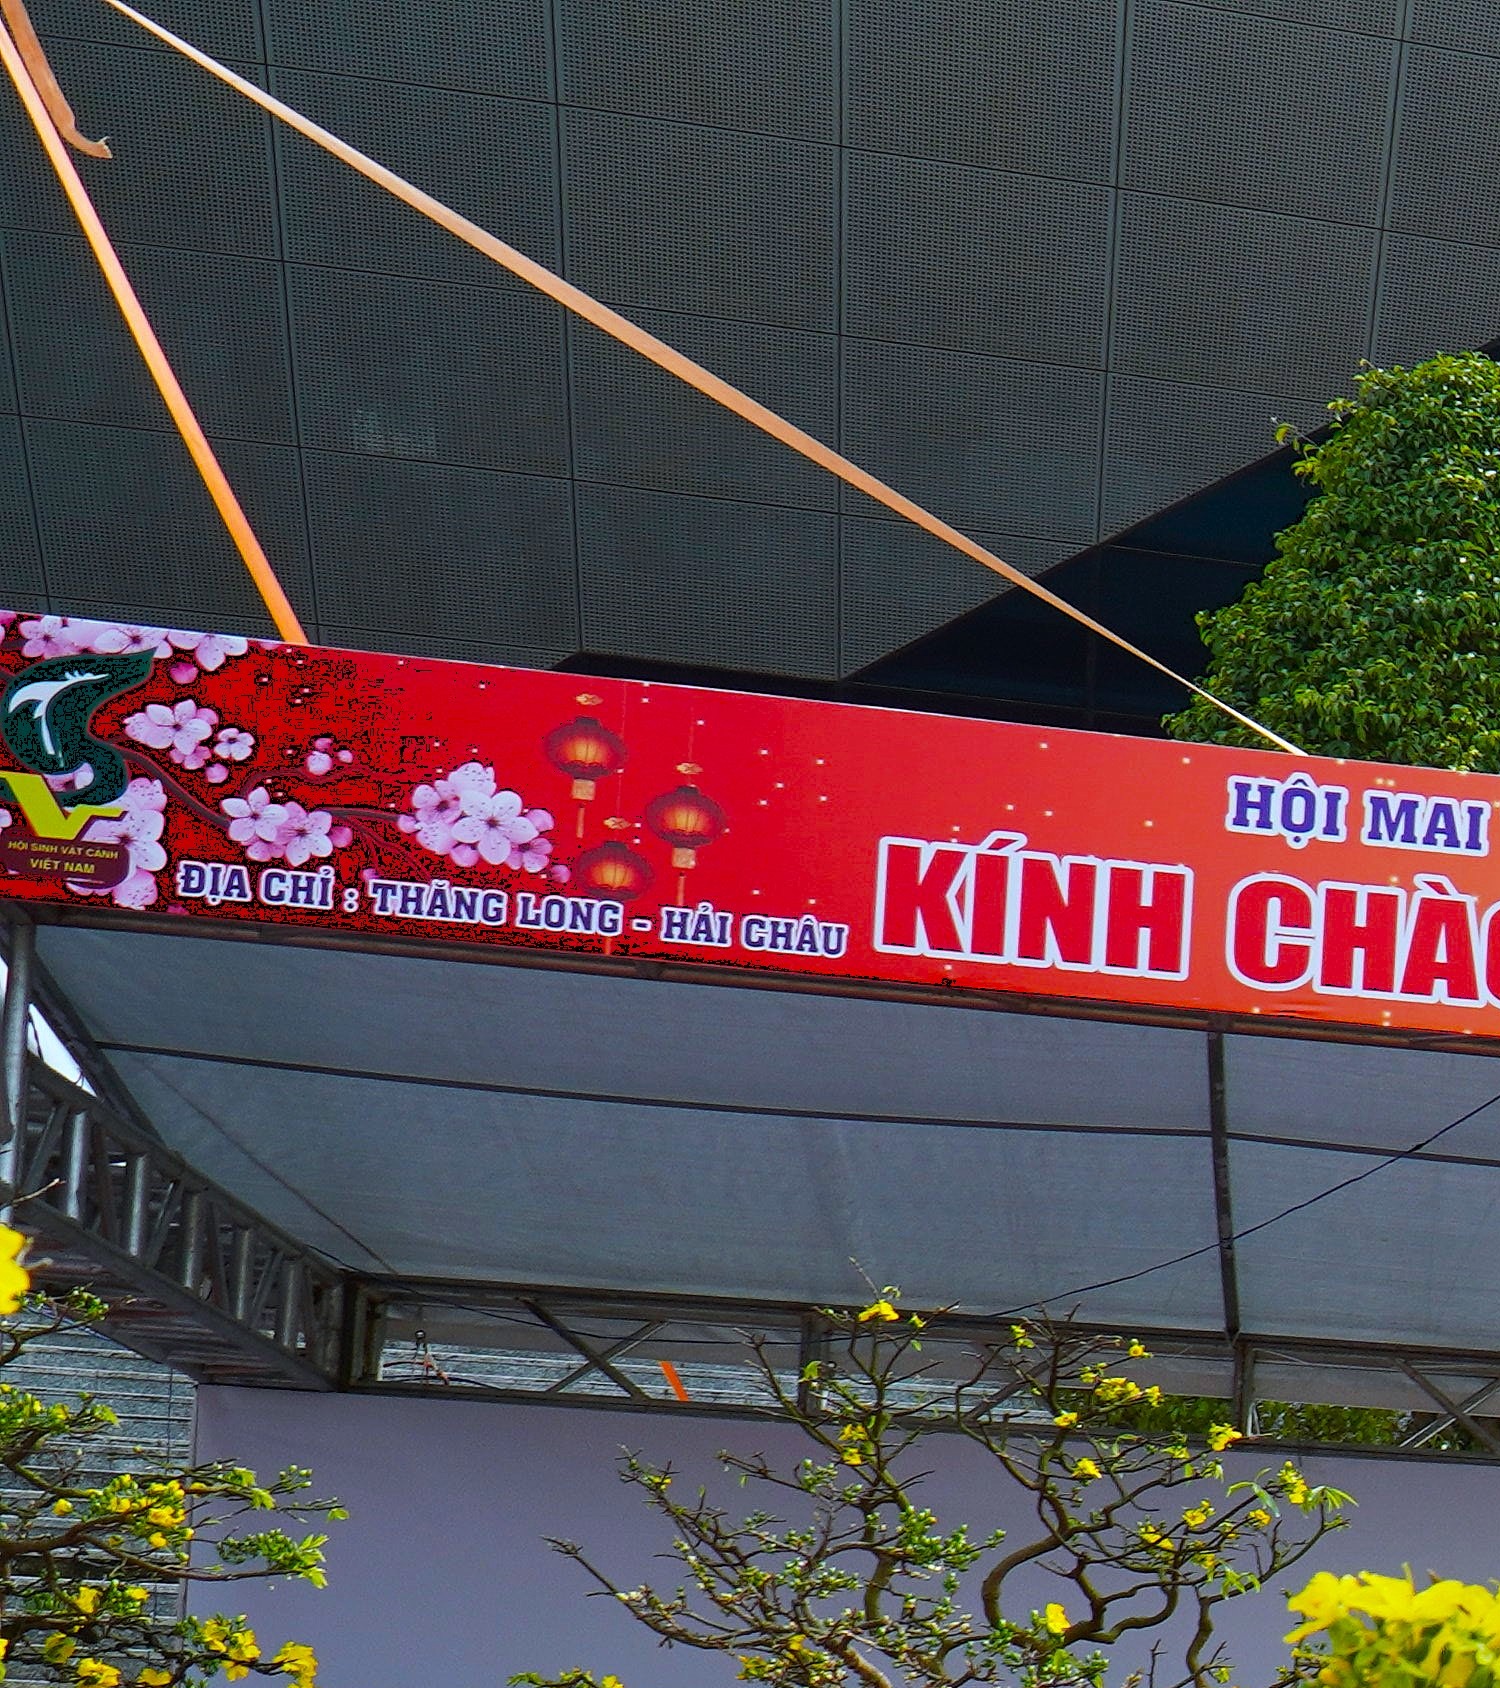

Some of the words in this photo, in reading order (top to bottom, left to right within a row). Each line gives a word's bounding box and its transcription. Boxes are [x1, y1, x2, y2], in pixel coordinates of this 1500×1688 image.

[30, 843, 58, 854] SINH
[1226, 772, 1348, 849] HỘI
[1361, 788, 1490, 857] MAI
[64, 862, 95, 874] NAM
[178, 861, 252, 905] ĐỊA
[260, 865, 333, 910] CHỈ
[369, 879, 507, 926] THĂNG
[516, 892, 624, 937] LONG
[661, 901, 733, 947] HẢI
[741, 914, 849, 959] CHÂU
[874, 831, 1195, 982] KÍNH
